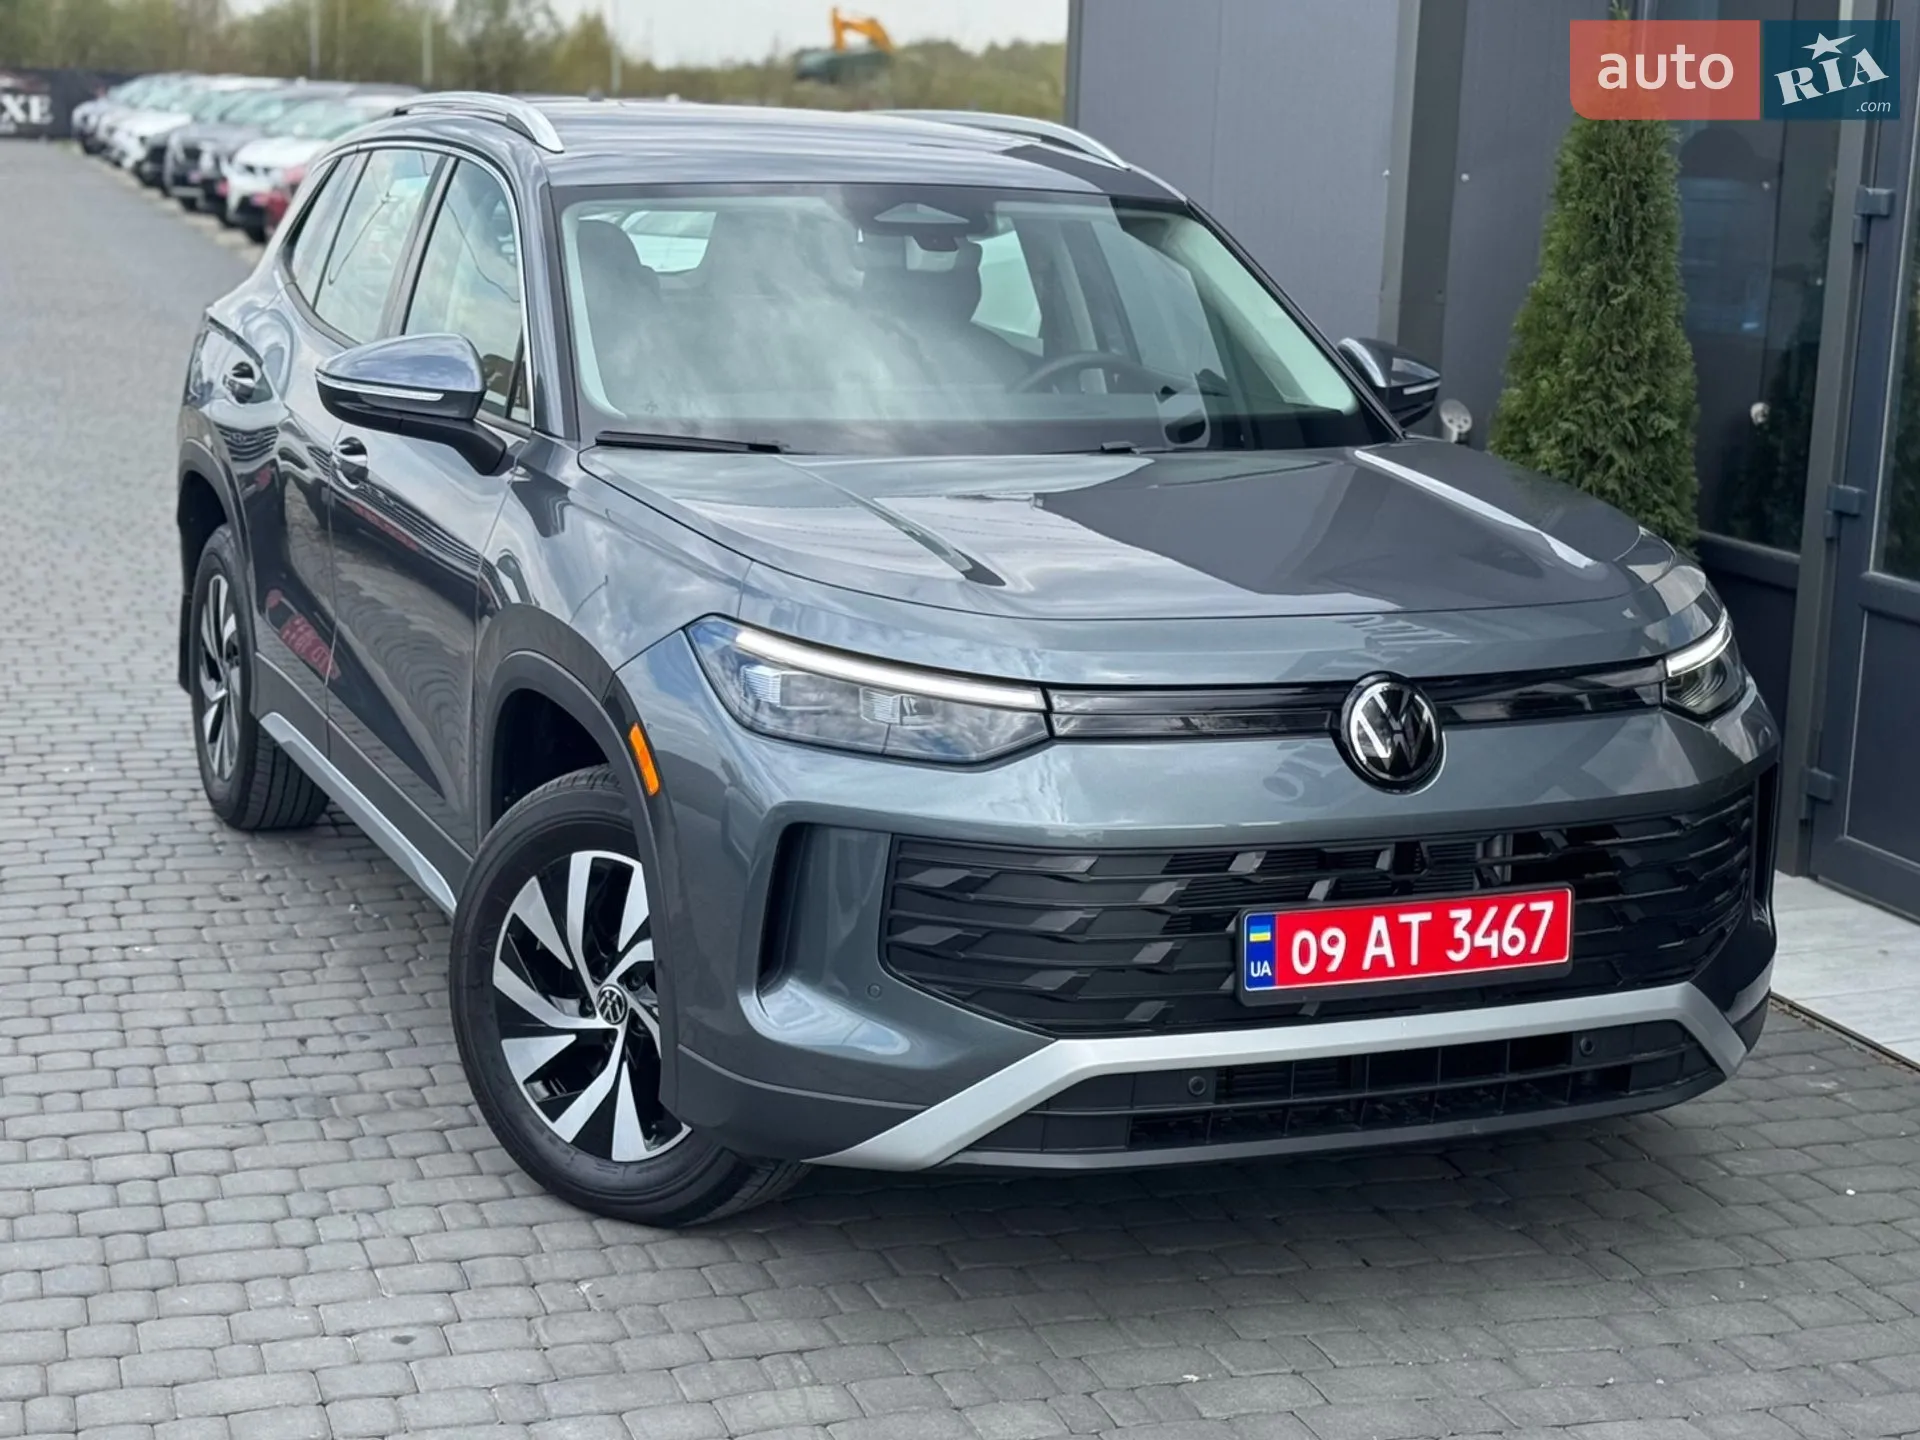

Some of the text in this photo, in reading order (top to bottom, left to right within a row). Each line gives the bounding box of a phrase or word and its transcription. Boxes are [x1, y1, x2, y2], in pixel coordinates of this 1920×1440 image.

[1291, 900, 1554, 975] 09 AT 3467
[1251, 960, 1272, 977] UA
